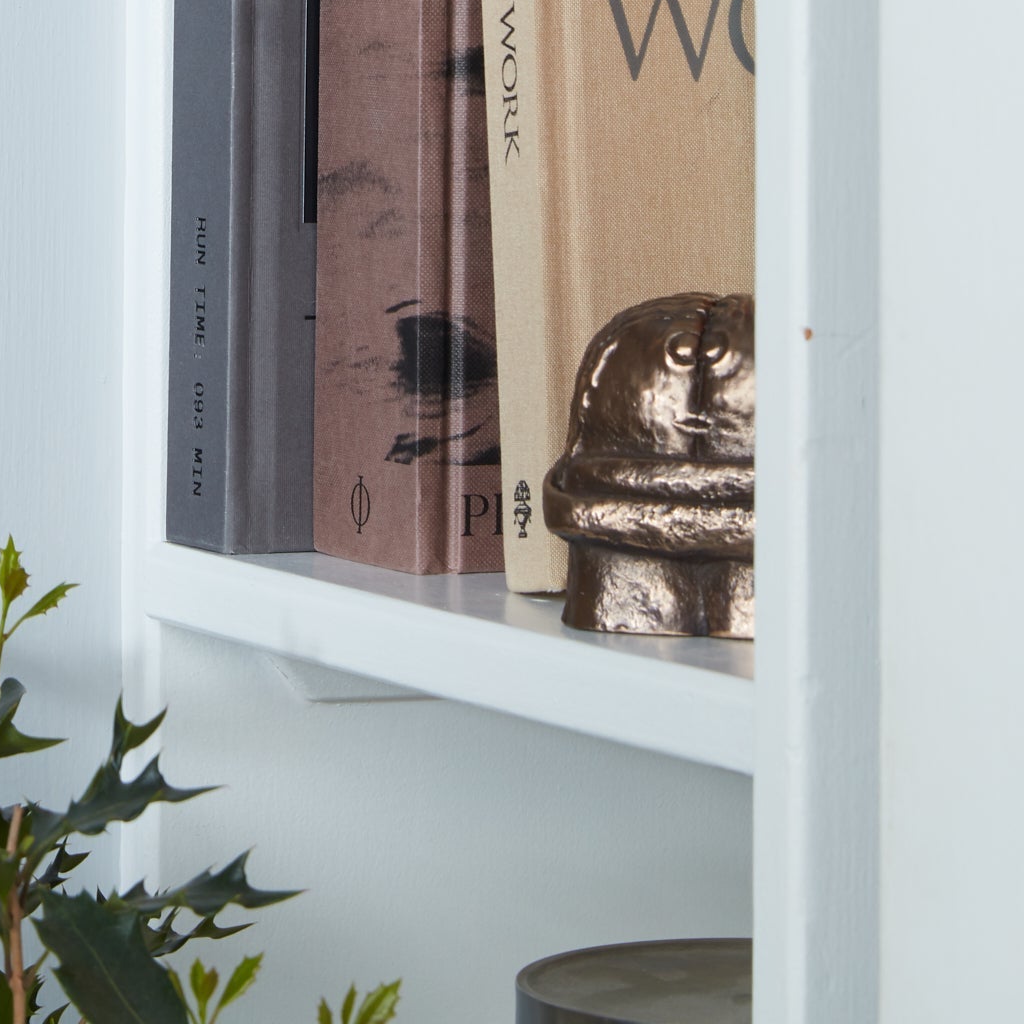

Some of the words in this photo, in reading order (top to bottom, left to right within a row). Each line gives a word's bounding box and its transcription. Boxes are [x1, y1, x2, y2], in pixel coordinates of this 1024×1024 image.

[499, 1, 521, 166] WORK
[195, 216, 207, 266] RUN
[194, 285, 206, 360] TIME:
[193, 381, 205, 431] 093
[191, 448, 203, 497] MIN
